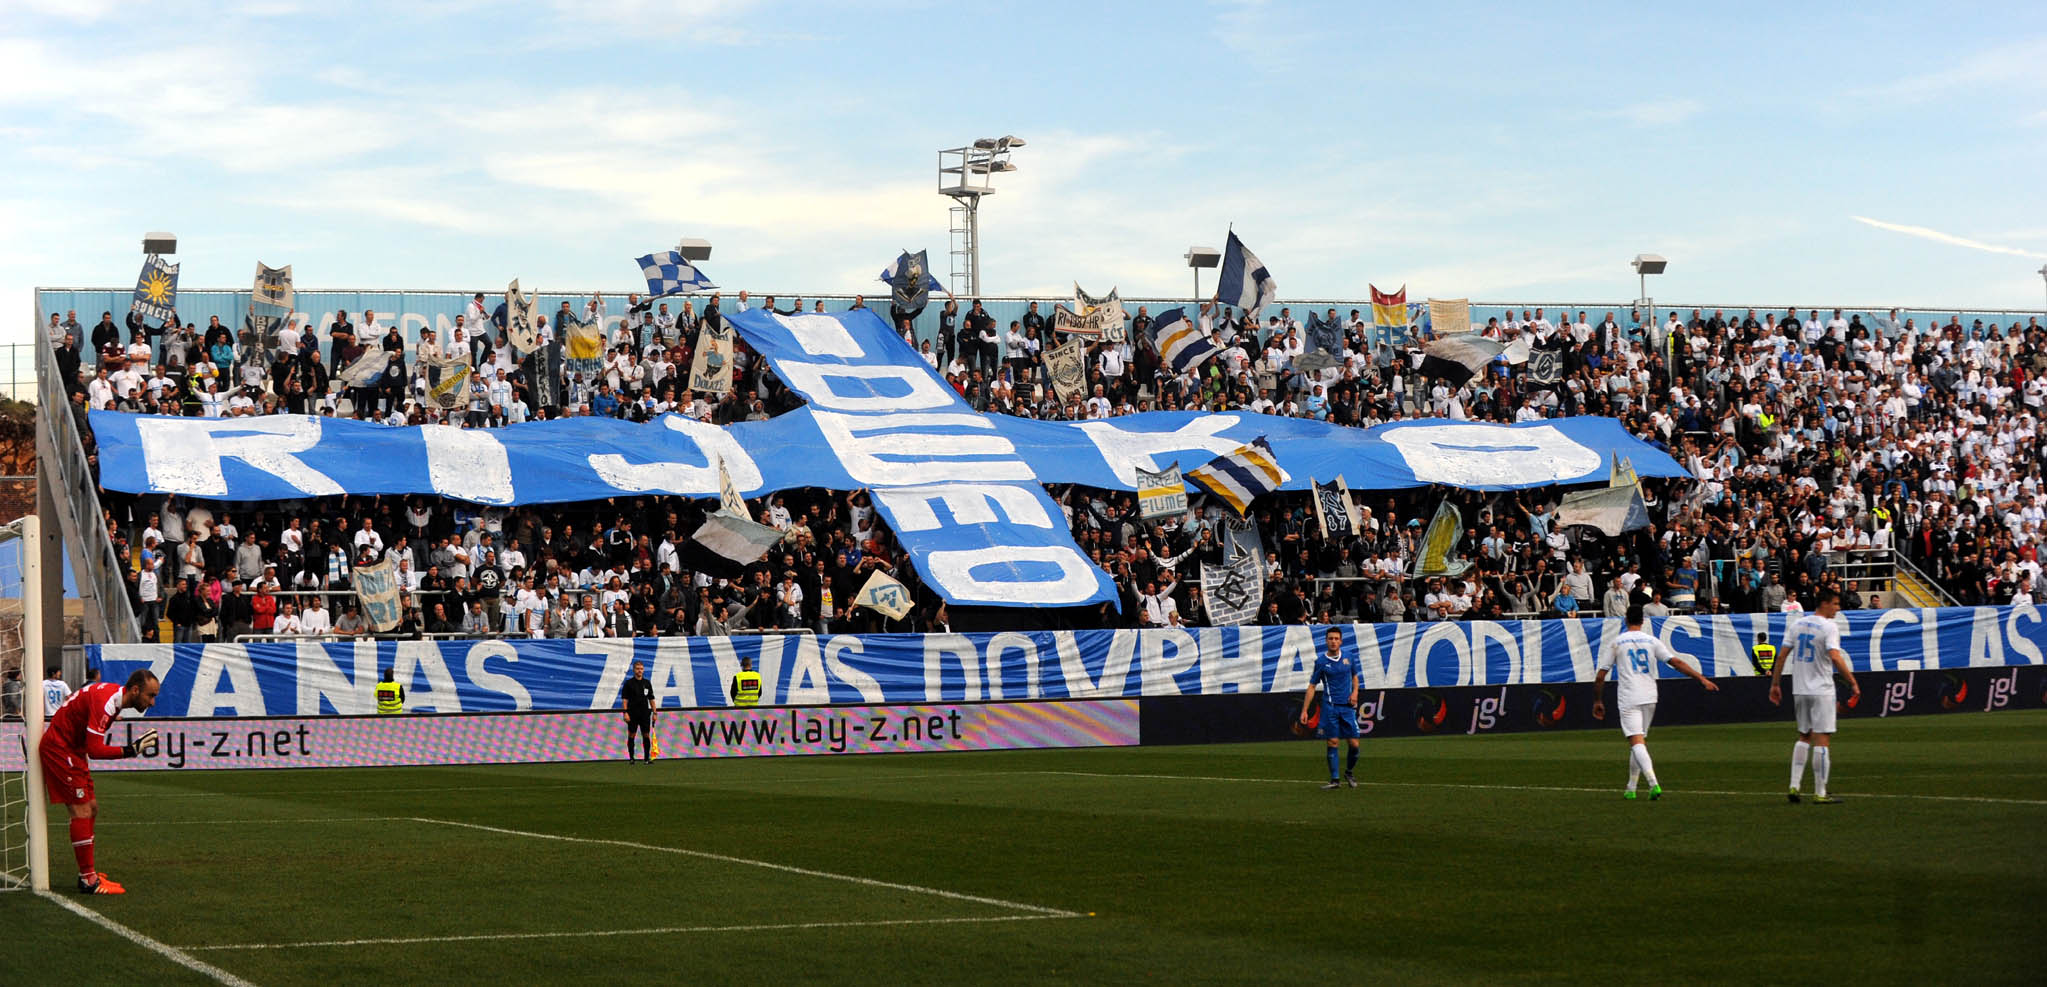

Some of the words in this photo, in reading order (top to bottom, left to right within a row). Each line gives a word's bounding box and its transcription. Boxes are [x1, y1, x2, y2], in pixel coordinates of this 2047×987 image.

[135, 300, 173, 321] SUNCE!
[1049, 345, 1075, 360] SINCE
[1136, 471, 1181, 489] FORZA
[1140, 494, 1187, 514] FIUME
[1628, 648, 1649, 674] 19
[1797, 633, 1816, 662] 15
[101, 643, 267, 717] ZA
[296, 640, 533, 716] NAS
[574, 636, 698, 710] ZA
[707, 634, 886, 707] VAS
[1052, 624, 1323, 697] VRHA
[1353, 618, 1542, 688] VODI
[48, 689, 61, 704] 91
[1880, 671, 1915, 718] jgl
[1983, 667, 2018, 713] jgl
[1357, 691, 1385, 734] gl
[1466, 686, 1507, 735] jgl
[689, 709, 962, 752] www.lay-z.net
